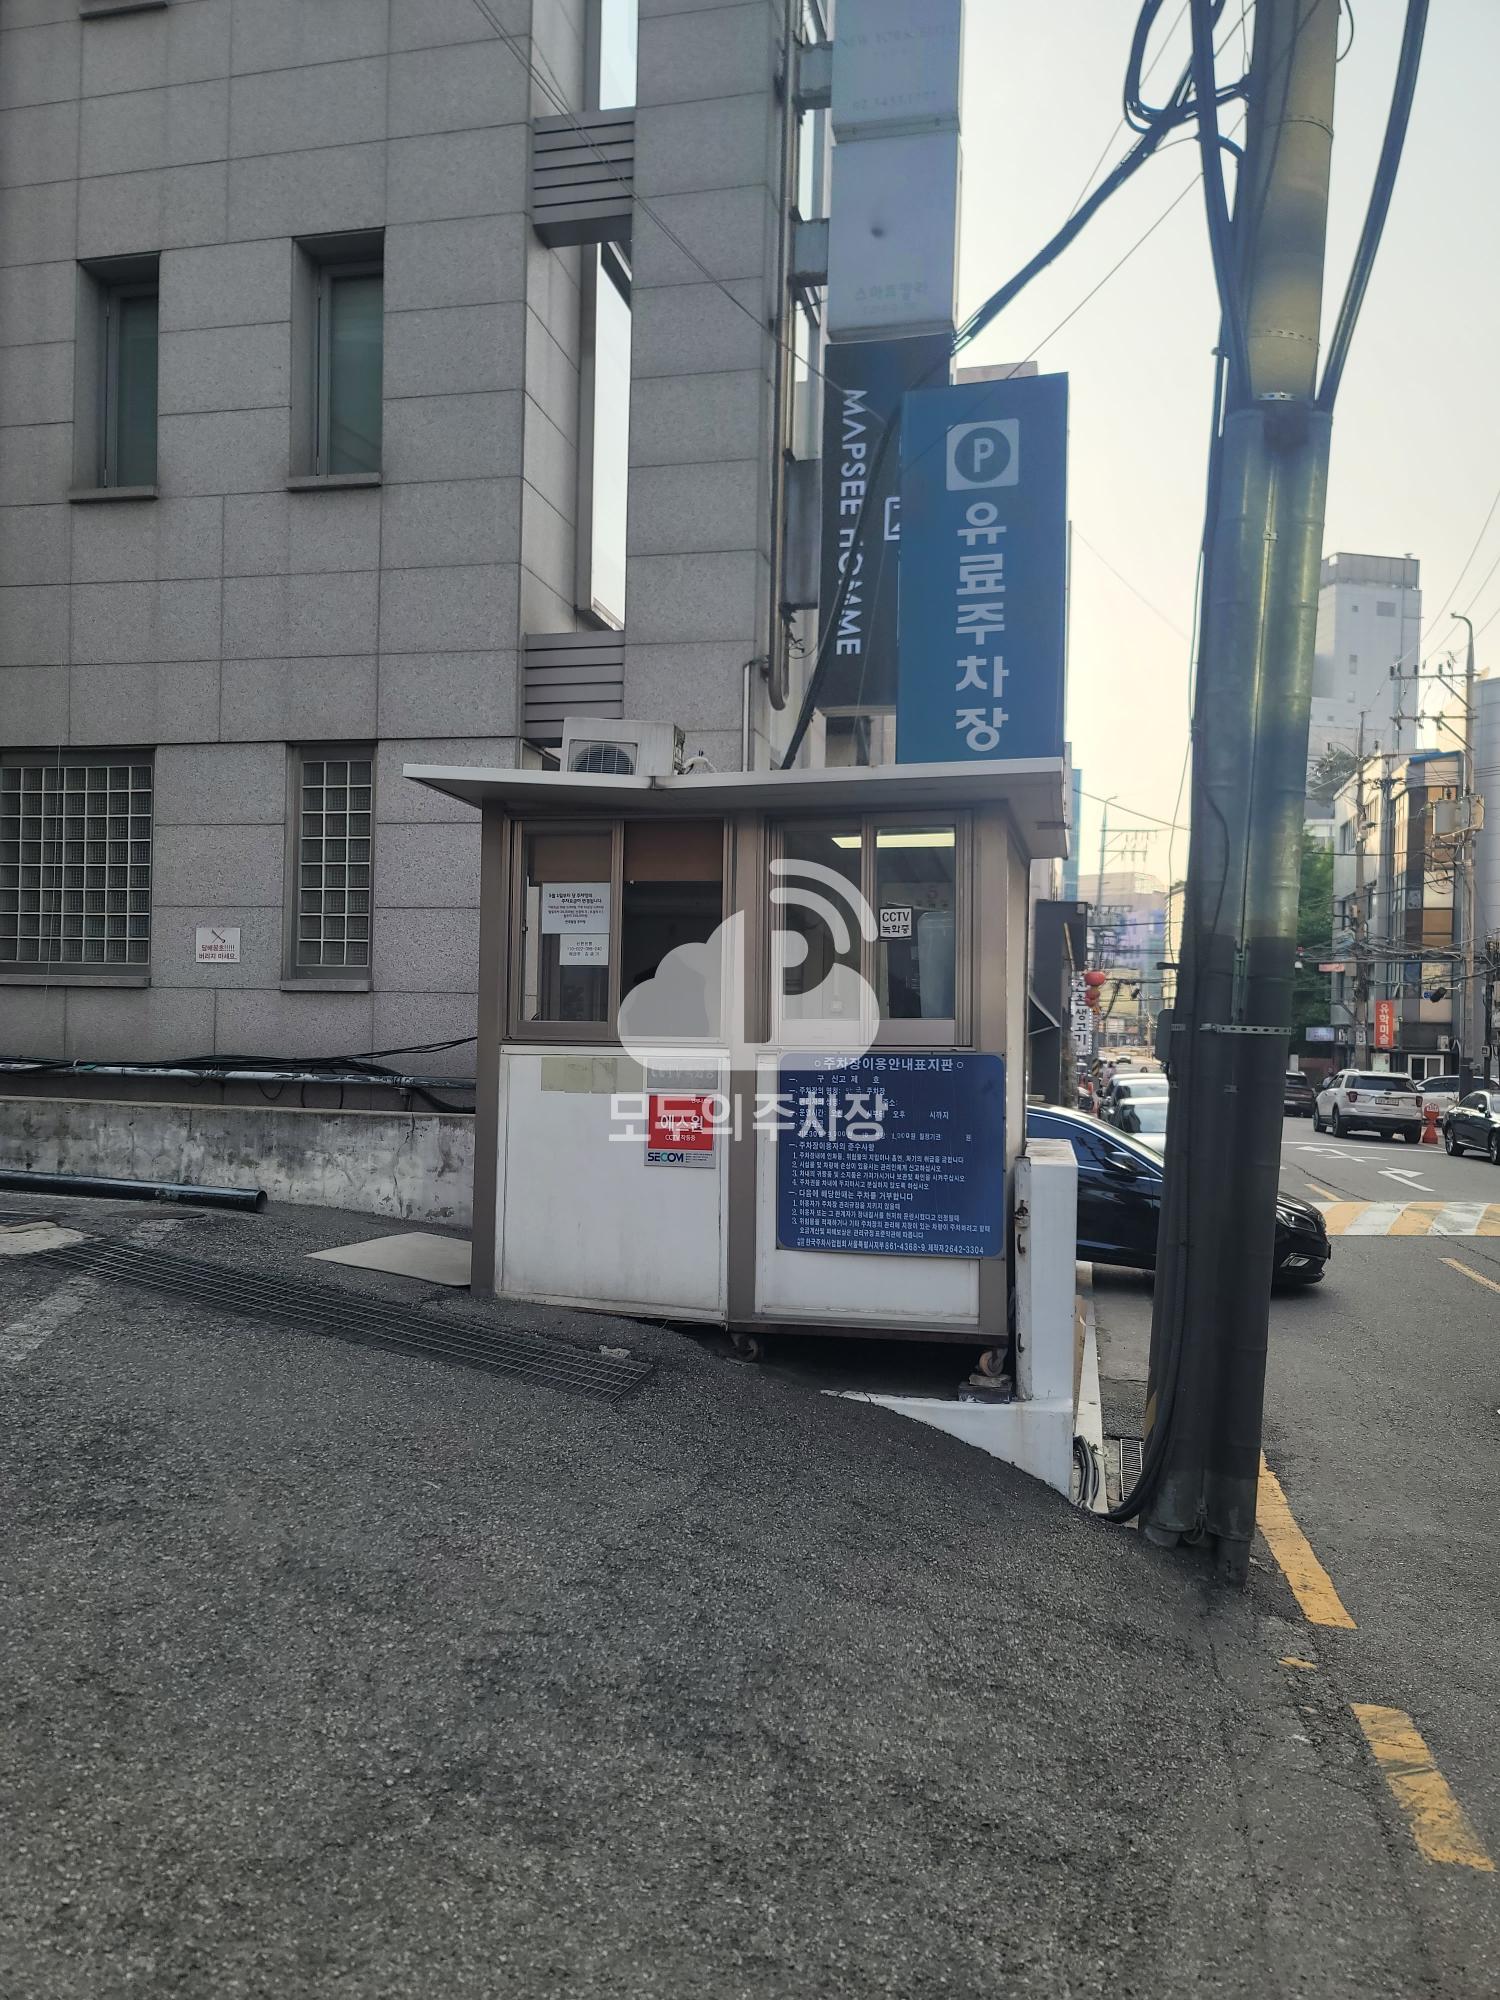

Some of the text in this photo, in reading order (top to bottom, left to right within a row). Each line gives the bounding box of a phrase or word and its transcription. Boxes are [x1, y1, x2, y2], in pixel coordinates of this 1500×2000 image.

[840, 389, 868, 516] MAPSEE
[973, 437, 995, 473] P
[956, 502, 1009, 752] 유료주차장
[882, 912, 910, 922] CCTV
[882, 924, 910, 934] 녹화중
[648, 1152, 684, 1163] SECOM
